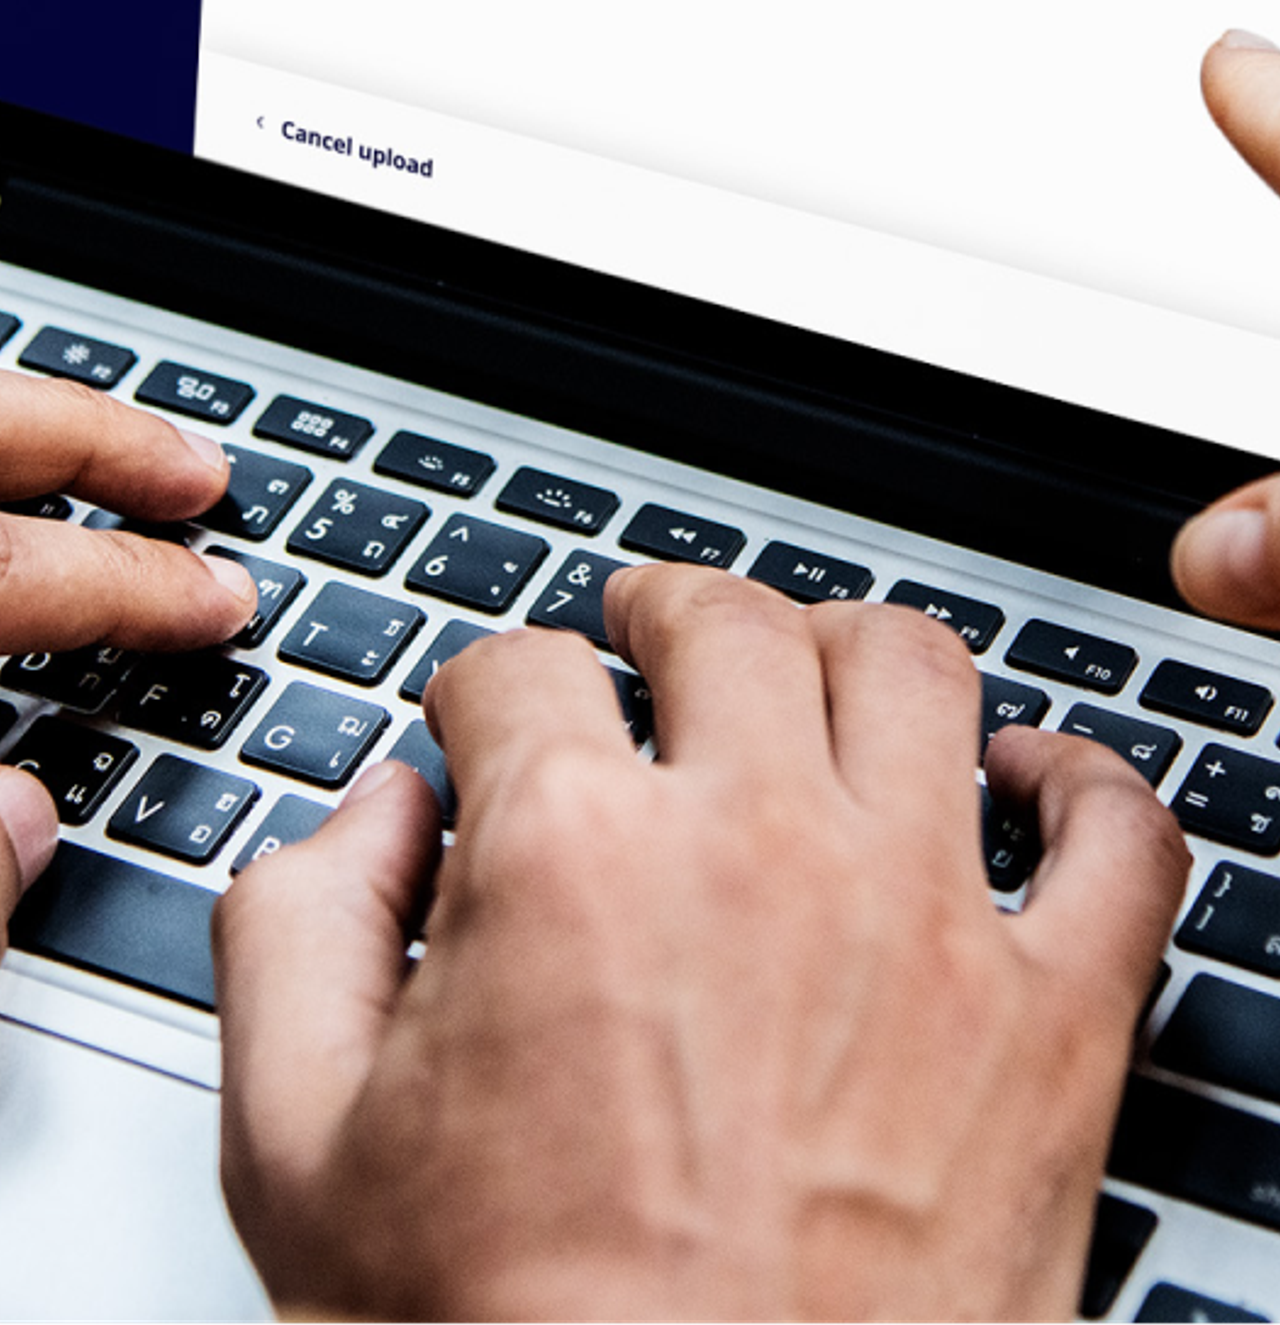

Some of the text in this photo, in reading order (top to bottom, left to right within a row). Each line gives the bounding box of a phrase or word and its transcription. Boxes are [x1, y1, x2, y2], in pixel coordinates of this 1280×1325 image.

[280, 121, 434, 178] Cancel upload
[91, 364, 112, 379] F2
[210, 400, 230, 415] F3
[329, 435, 350, 450] F4
[451, 472, 471, 487] F5
[331, 488, 358, 515] %
[573, 510, 593, 525] F6
[305, 517, 333, 539] 5
[701, 547, 721, 562] F7
[424, 555, 449, 577] 6
[567, 562, 592, 588] &
[546, 590, 573, 613] 7
[829, 584, 849, 601] F8
[303, 621, 329, 646] T
[960, 625, 980, 640] F9
[1085, 663, 1112, 681] F10
[140, 684, 168, 706] F
[1224, 705, 1249, 723] F11
[264, 724, 296, 751] G
[135, 795, 165, 823] V
